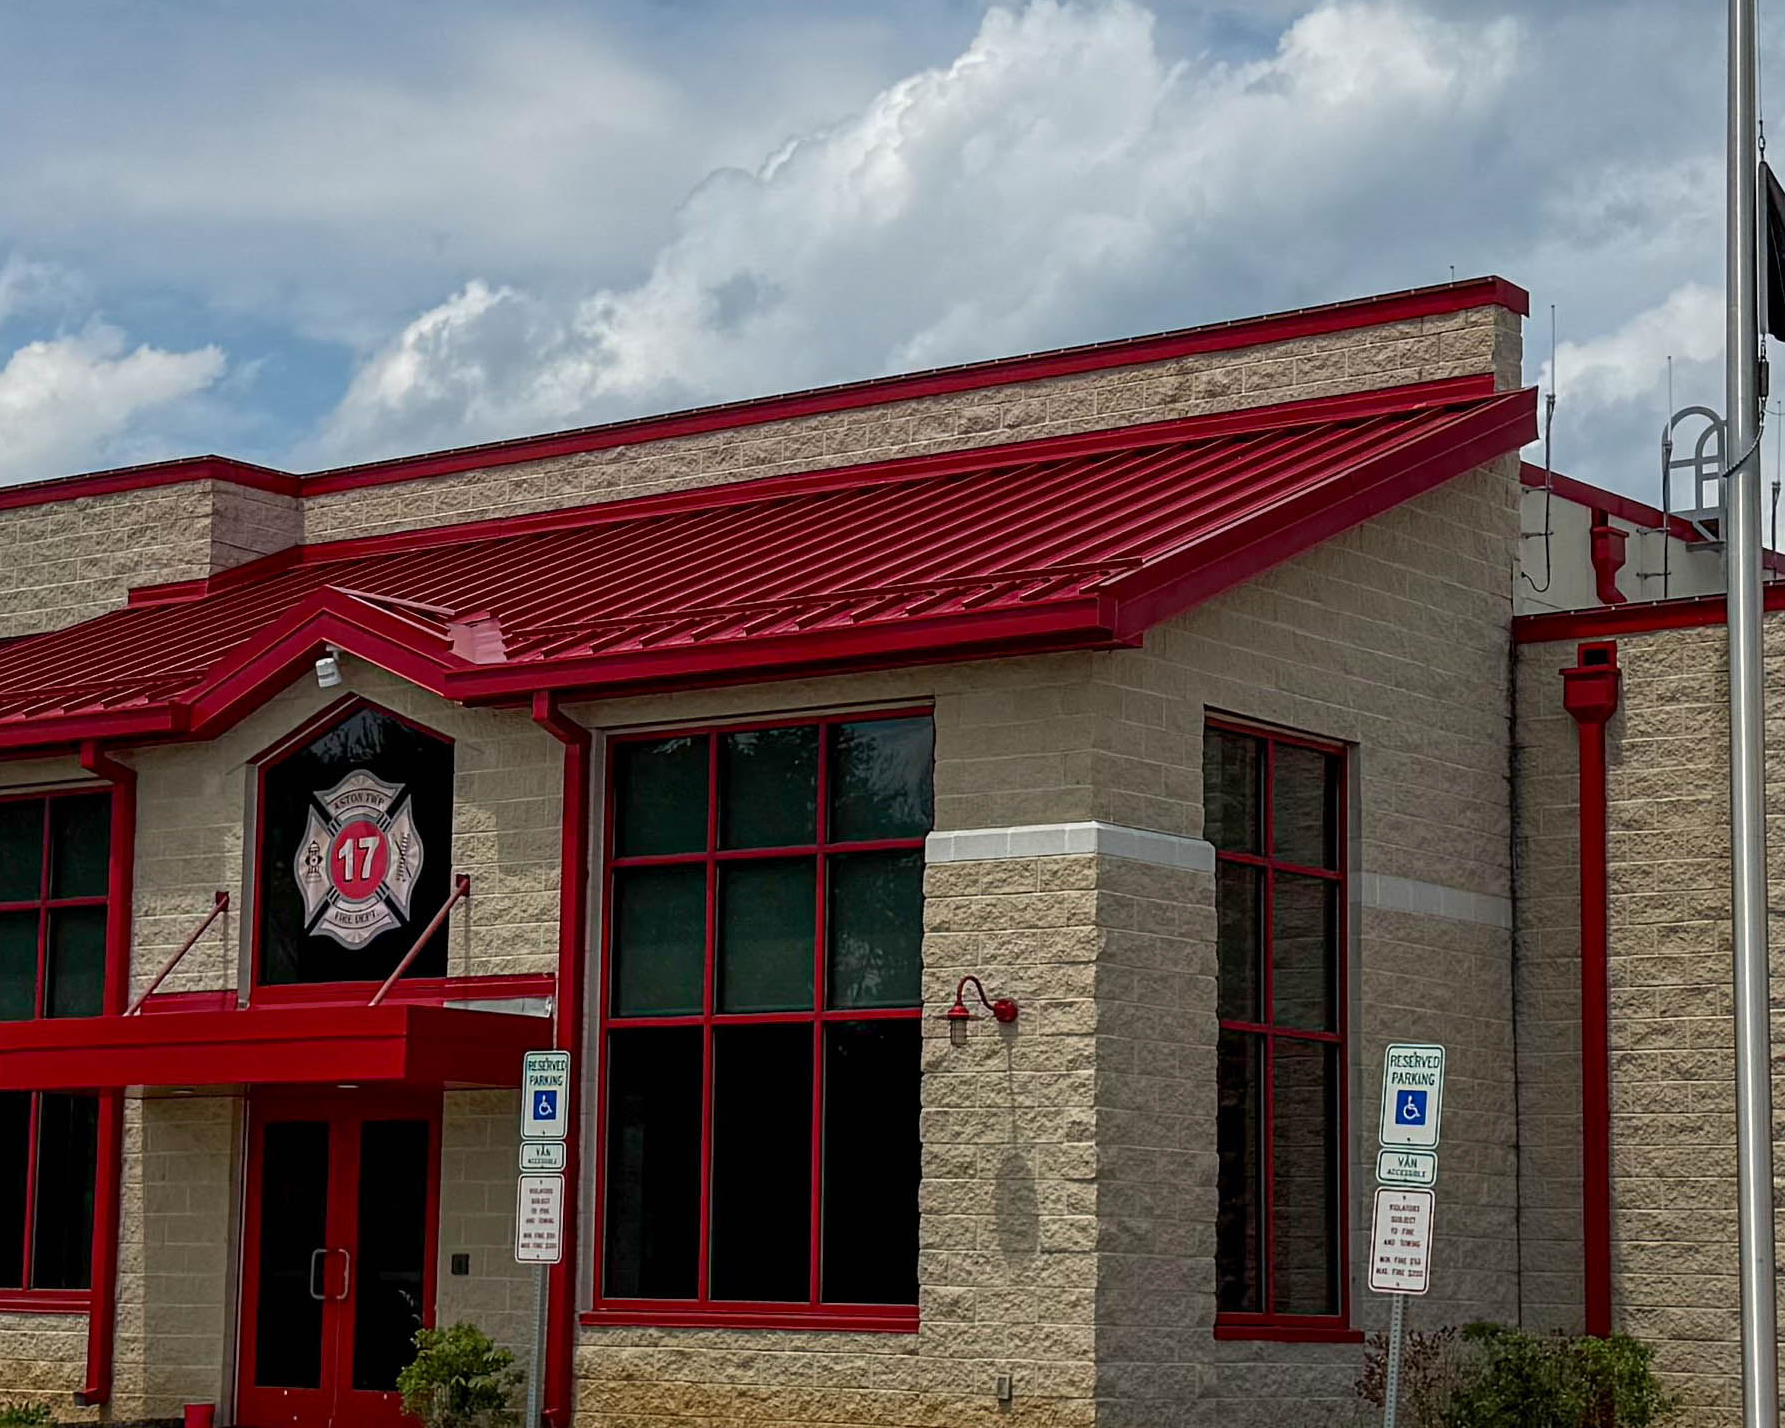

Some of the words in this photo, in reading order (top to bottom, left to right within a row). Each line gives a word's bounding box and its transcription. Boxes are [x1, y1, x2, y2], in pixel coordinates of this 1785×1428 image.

[337, 835, 380, 882] 17
[334, 911, 353, 924] FIRE
[528, 1059, 568, 1072] RESERVED
[1390, 1054, 1440, 1069] RESERVED
[529, 1075, 563, 1086] PARKING
[1391, 1072, 1435, 1086] PARKING
[1398, 1156, 1418, 1168] VAN
